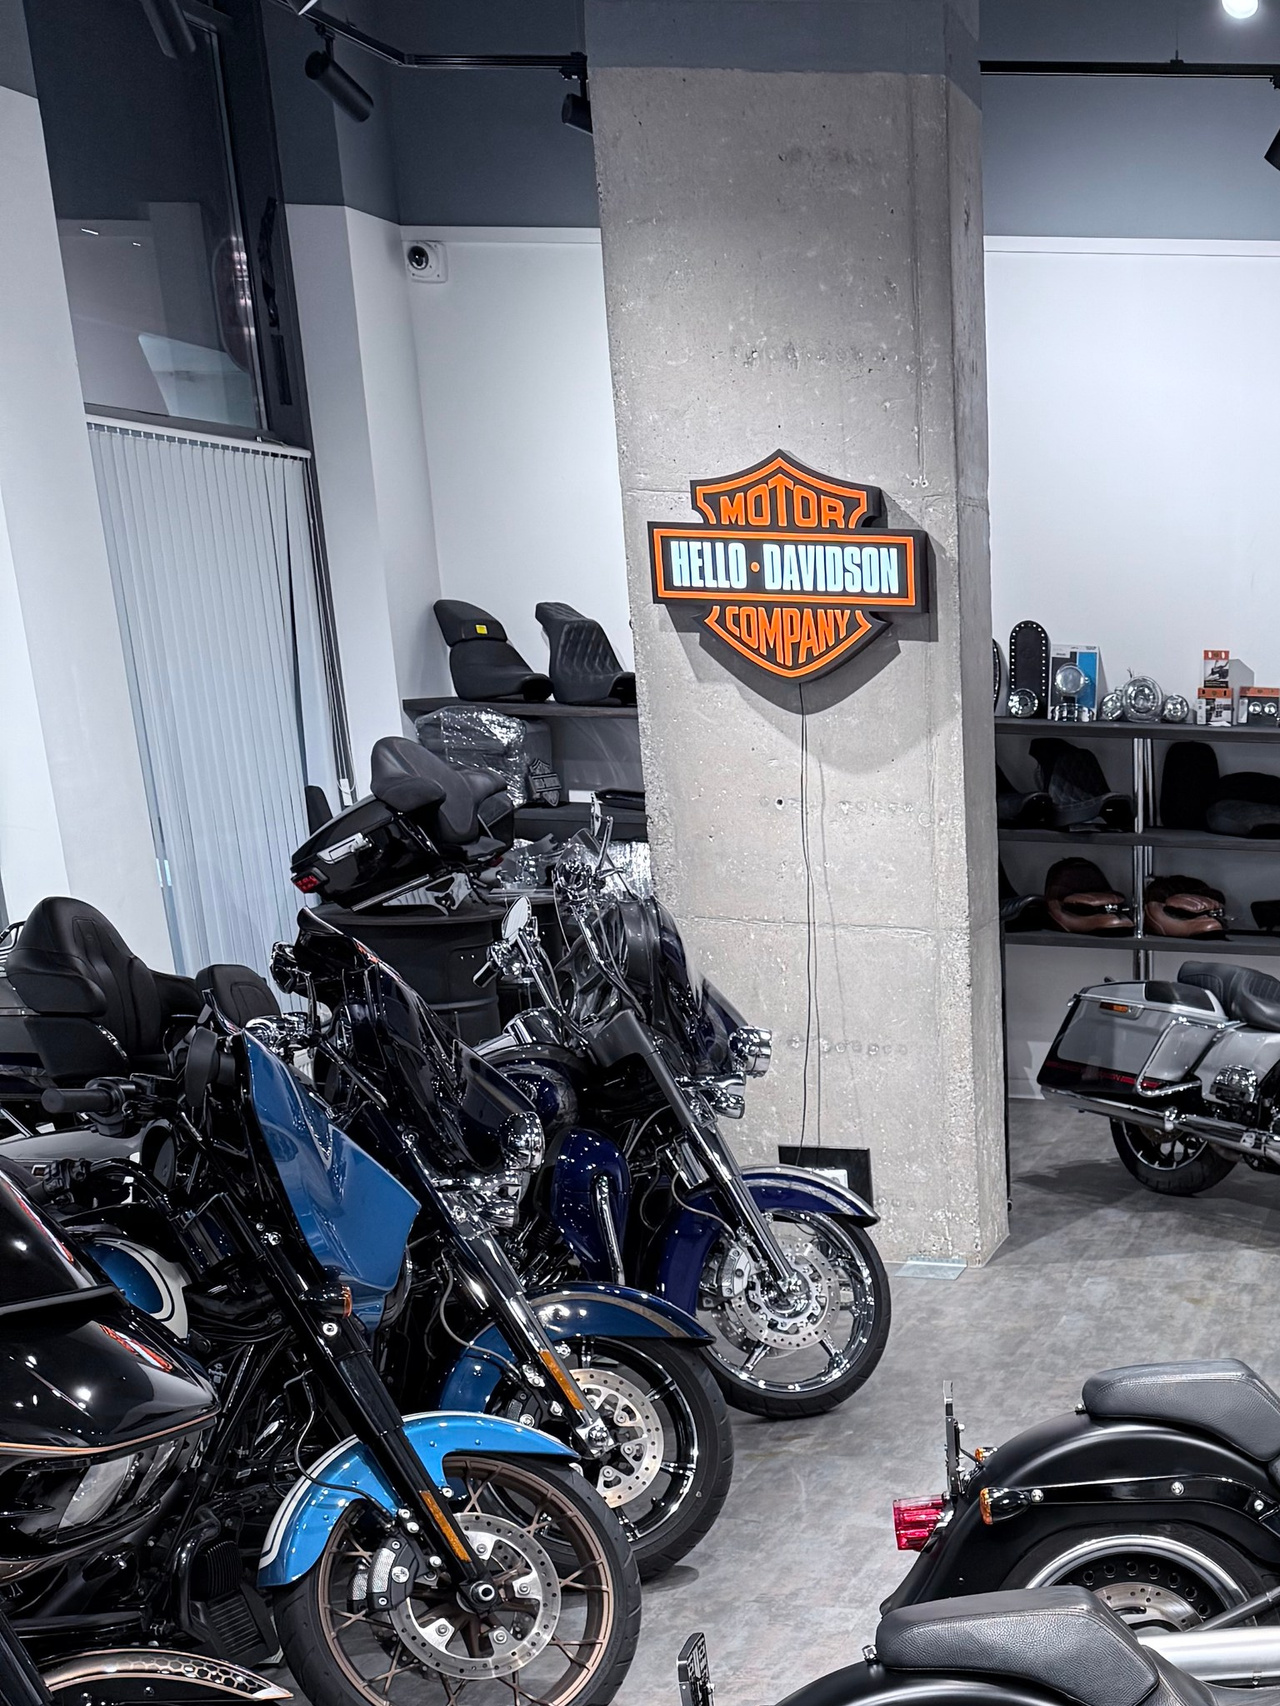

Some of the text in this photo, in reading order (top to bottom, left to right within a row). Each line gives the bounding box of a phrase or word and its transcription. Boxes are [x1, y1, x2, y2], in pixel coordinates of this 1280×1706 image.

[720, 473, 845, 529] MOTOR
[670, 540, 899, 594] HELLO DAVIDSON
[725, 605, 850, 667] COMPANY
